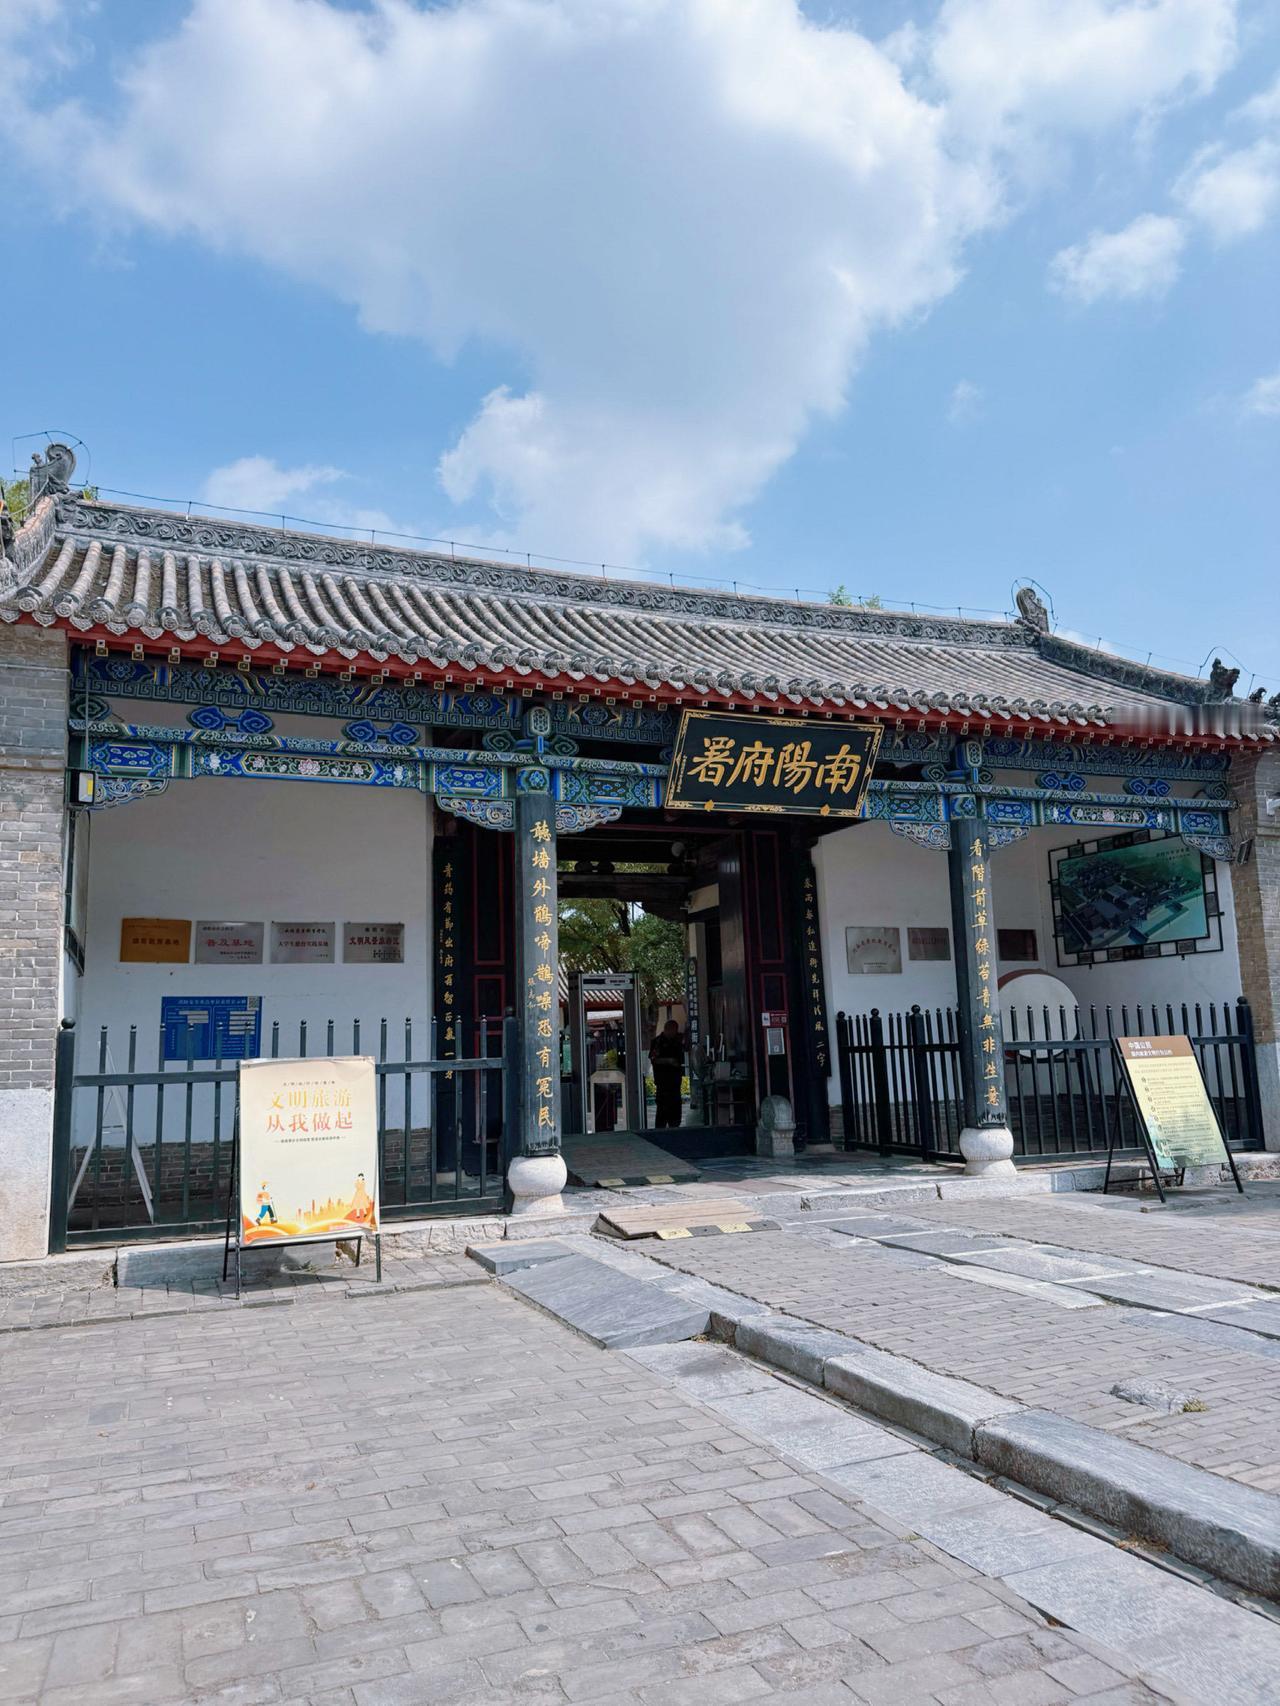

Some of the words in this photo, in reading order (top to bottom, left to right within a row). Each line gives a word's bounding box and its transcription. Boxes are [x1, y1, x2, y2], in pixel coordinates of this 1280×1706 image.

[272, 1089, 352, 1109] 文明旅游
[266, 1111, 352, 1133] 从我做起
